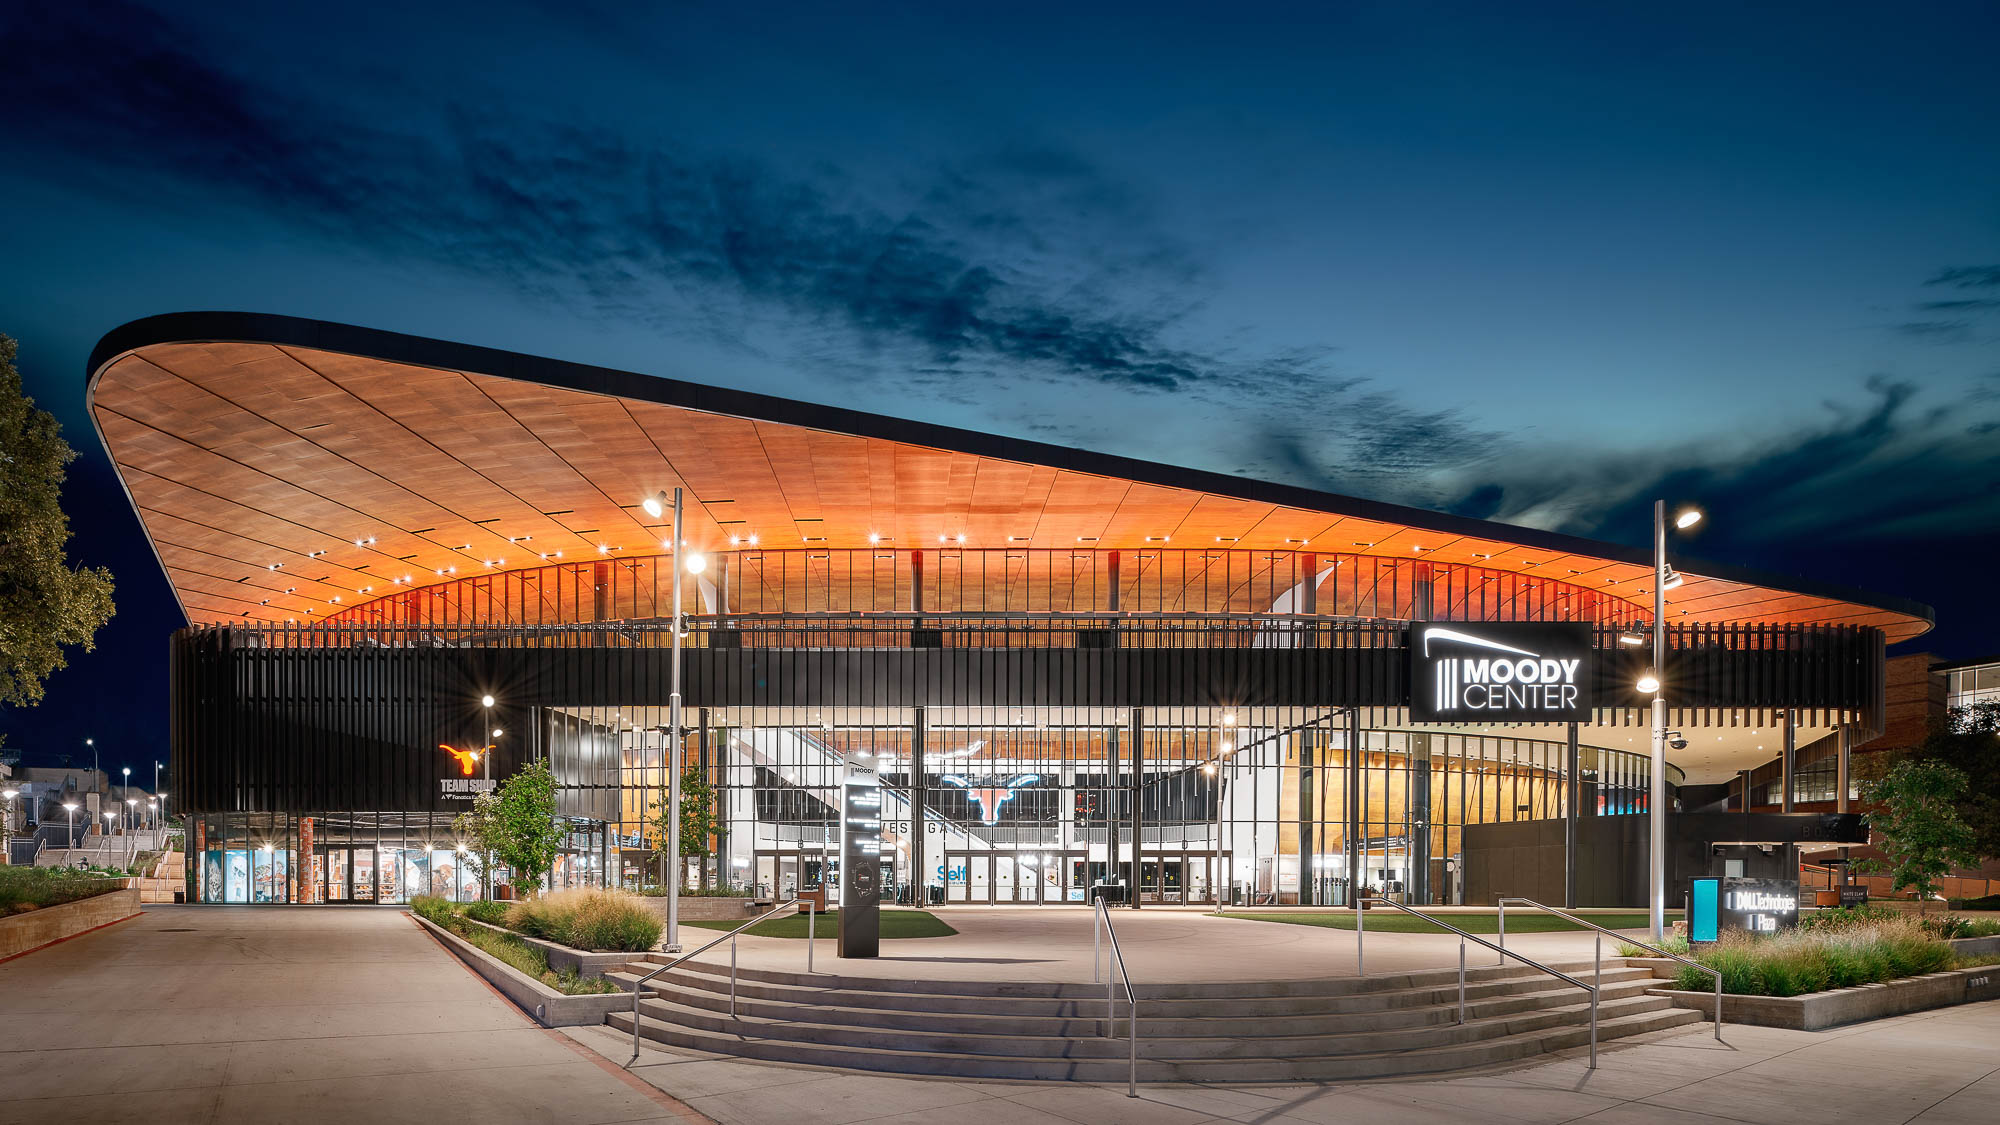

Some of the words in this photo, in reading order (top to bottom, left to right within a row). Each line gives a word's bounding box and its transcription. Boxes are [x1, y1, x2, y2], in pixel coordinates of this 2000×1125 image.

[1464, 659, 1580, 683] MOODY
[1464, 685, 1578, 709] CENTER
[441, 779, 468, 792] TEAM
[937, 865, 966, 880] Self
[1758, 914, 1776, 931] Plaza
